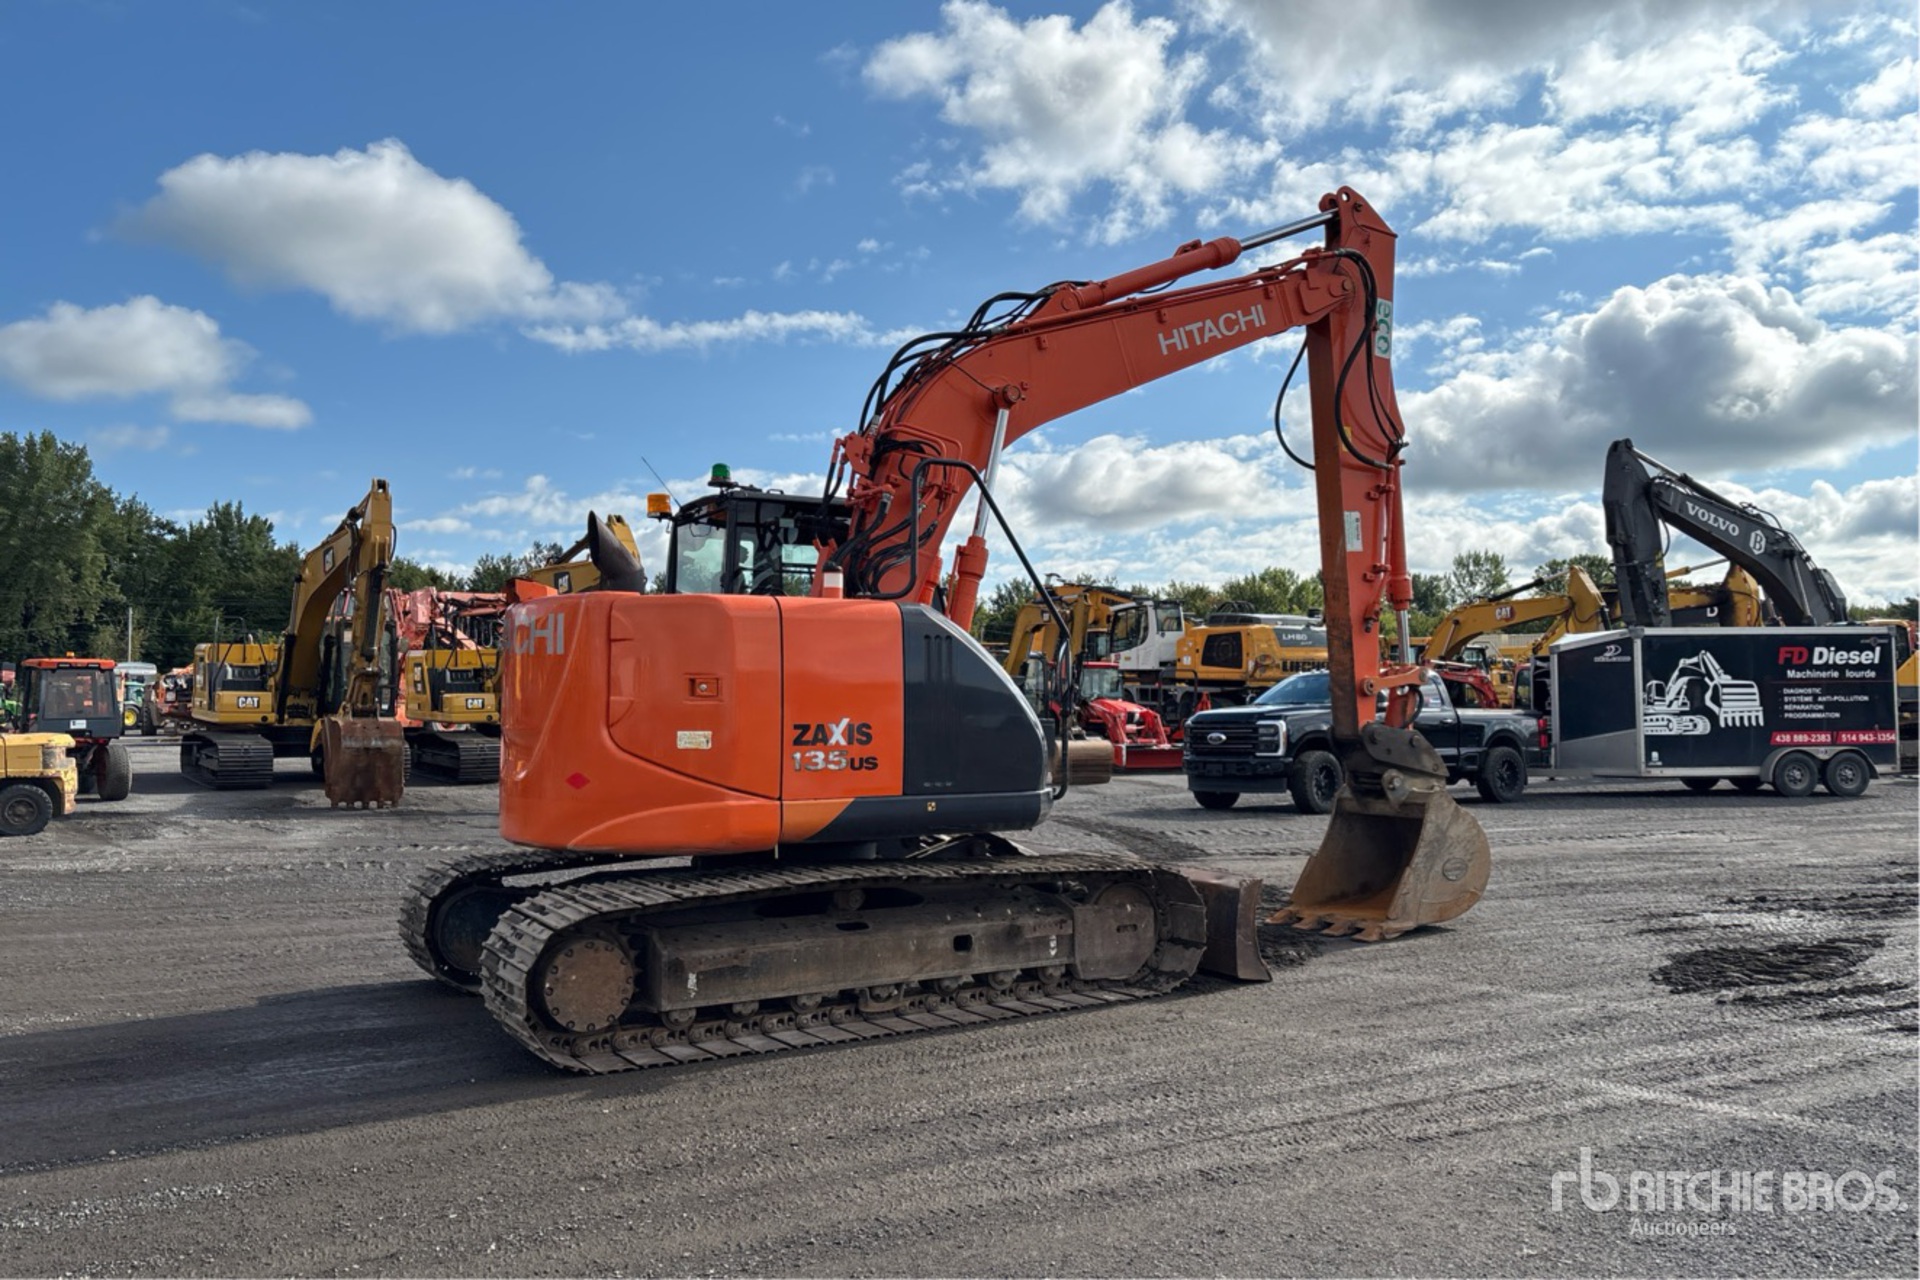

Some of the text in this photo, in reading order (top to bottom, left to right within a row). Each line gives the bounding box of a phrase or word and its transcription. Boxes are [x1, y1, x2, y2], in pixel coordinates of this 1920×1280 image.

[1158, 304, 1266, 355] HITACHI
[1686, 501, 1740, 537] VOLVO
[1495, 606, 1511, 620] CAT
[503, 612, 565, 655] CHI
[1777, 646, 1881, 665] FD Diesel
[1786, 669, 1876, 679] Machinerie lourde
[1783, 687, 1822, 695] DIAGNOSTIC
[238, 696, 259, 708] CAT
[466, 698, 483, 709] CAT
[1784, 711, 1841, 719] PROGRAMMATION
[792, 718, 873, 746] ZAXIS
[1841, 733, 1856, 742] 514
